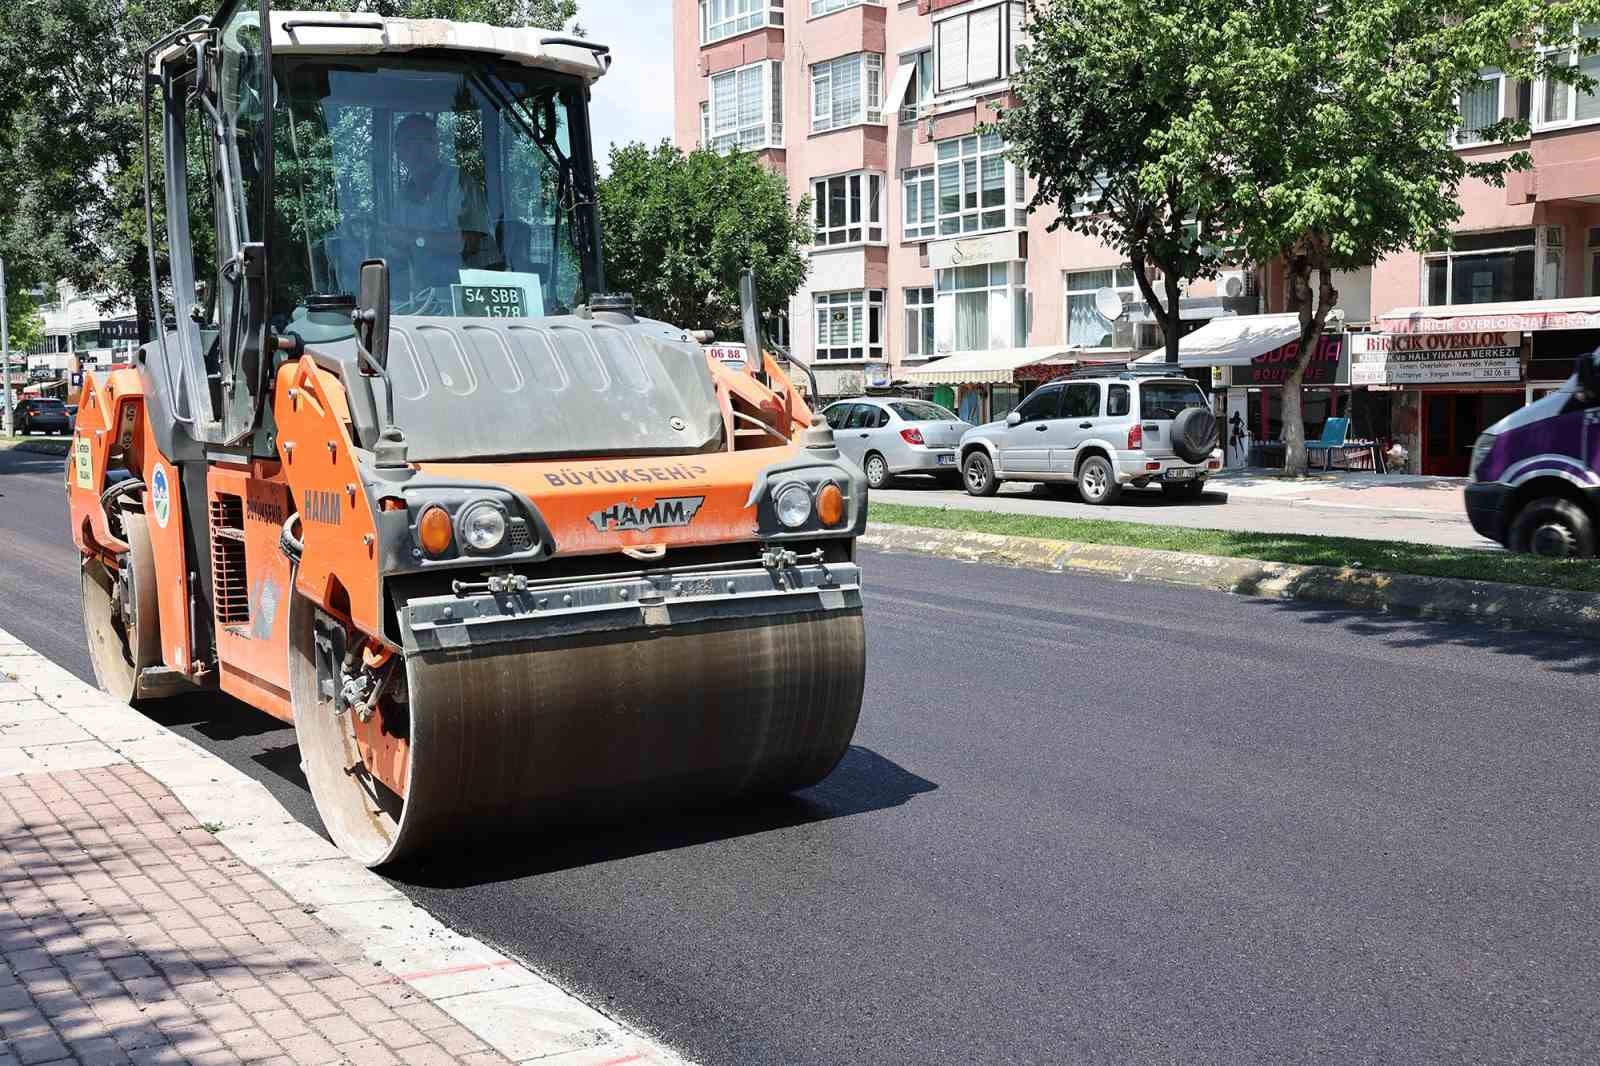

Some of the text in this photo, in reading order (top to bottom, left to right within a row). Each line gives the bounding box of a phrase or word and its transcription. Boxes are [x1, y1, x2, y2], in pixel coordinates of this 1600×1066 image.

[465, 289, 519, 303] 54 SBB
[1432, 350, 1469, 360] YIKAMA
[304, 490, 341, 525] HAMM
[602, 501, 685, 527] HAMM
